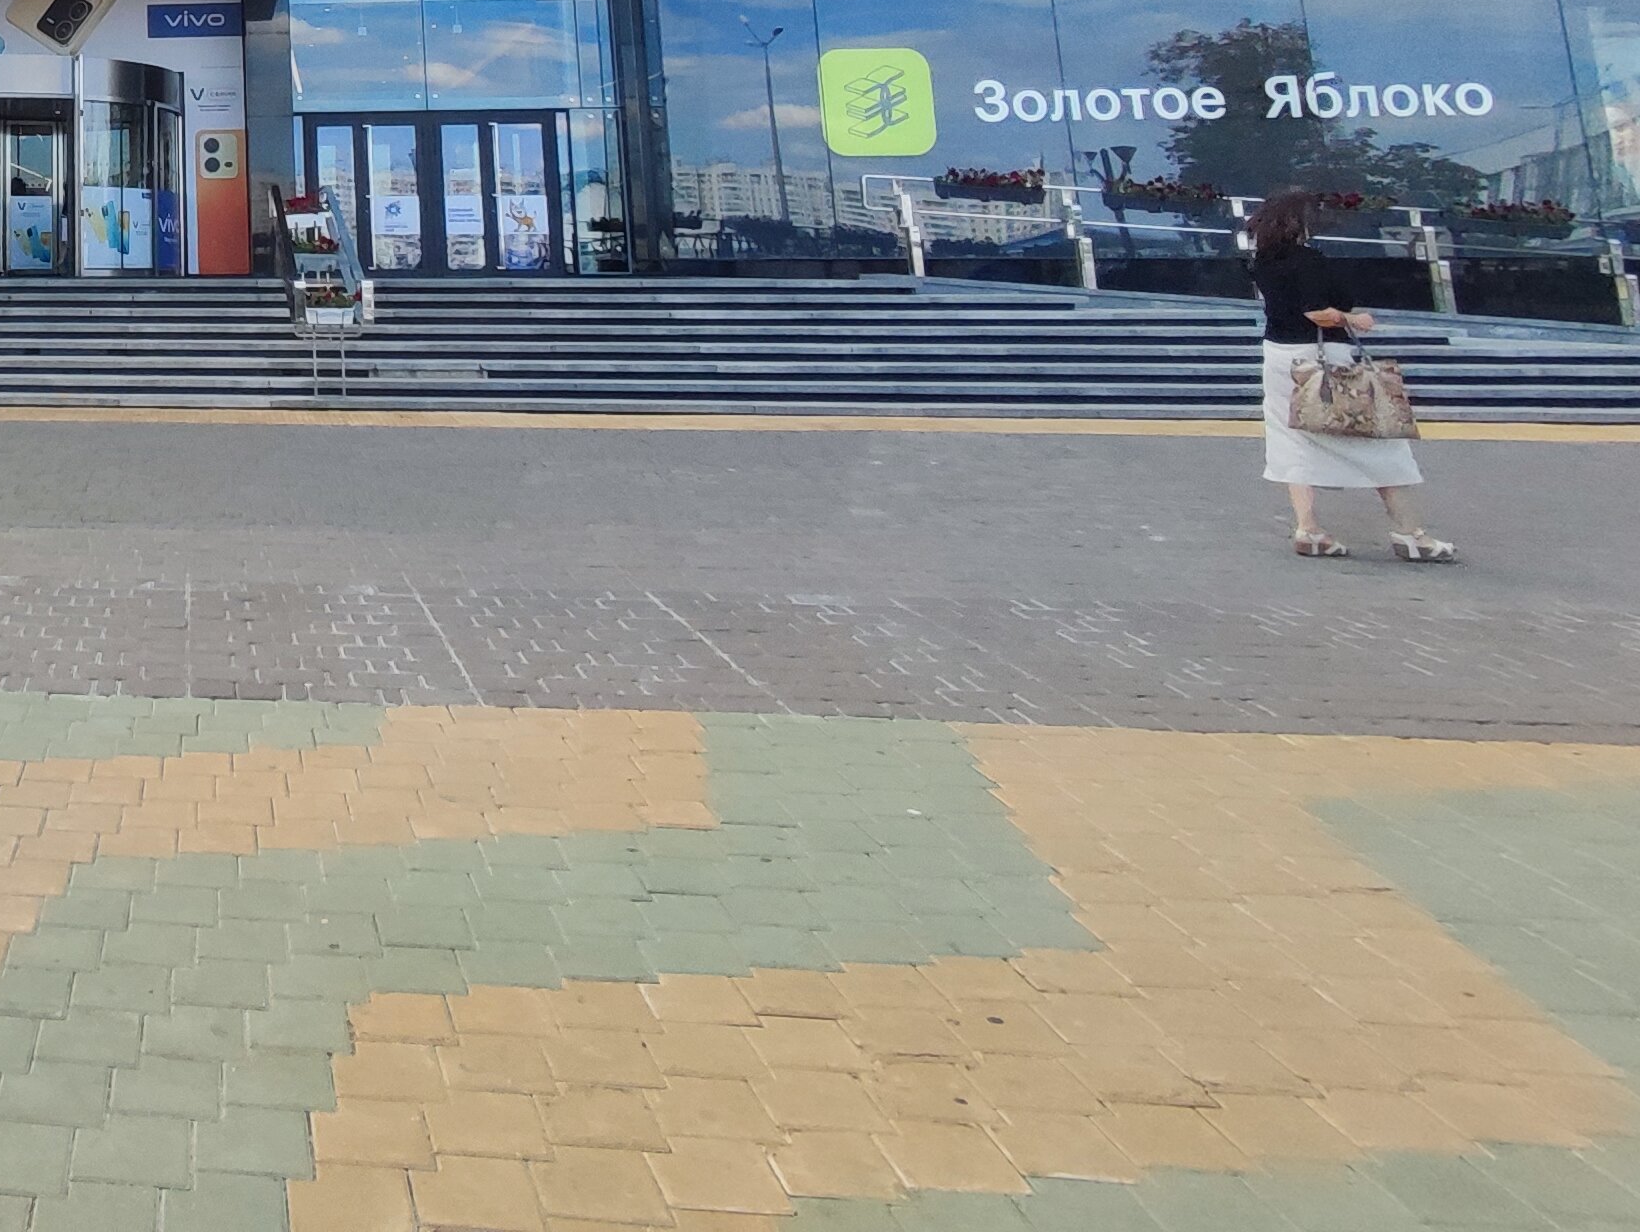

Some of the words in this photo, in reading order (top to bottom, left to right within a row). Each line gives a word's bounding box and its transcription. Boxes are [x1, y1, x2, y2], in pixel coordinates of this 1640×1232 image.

[164, 10, 226, 28] vivo
[973, 79, 1227, 123] Золотое
[1265, 72, 1493, 119] Яблоко
